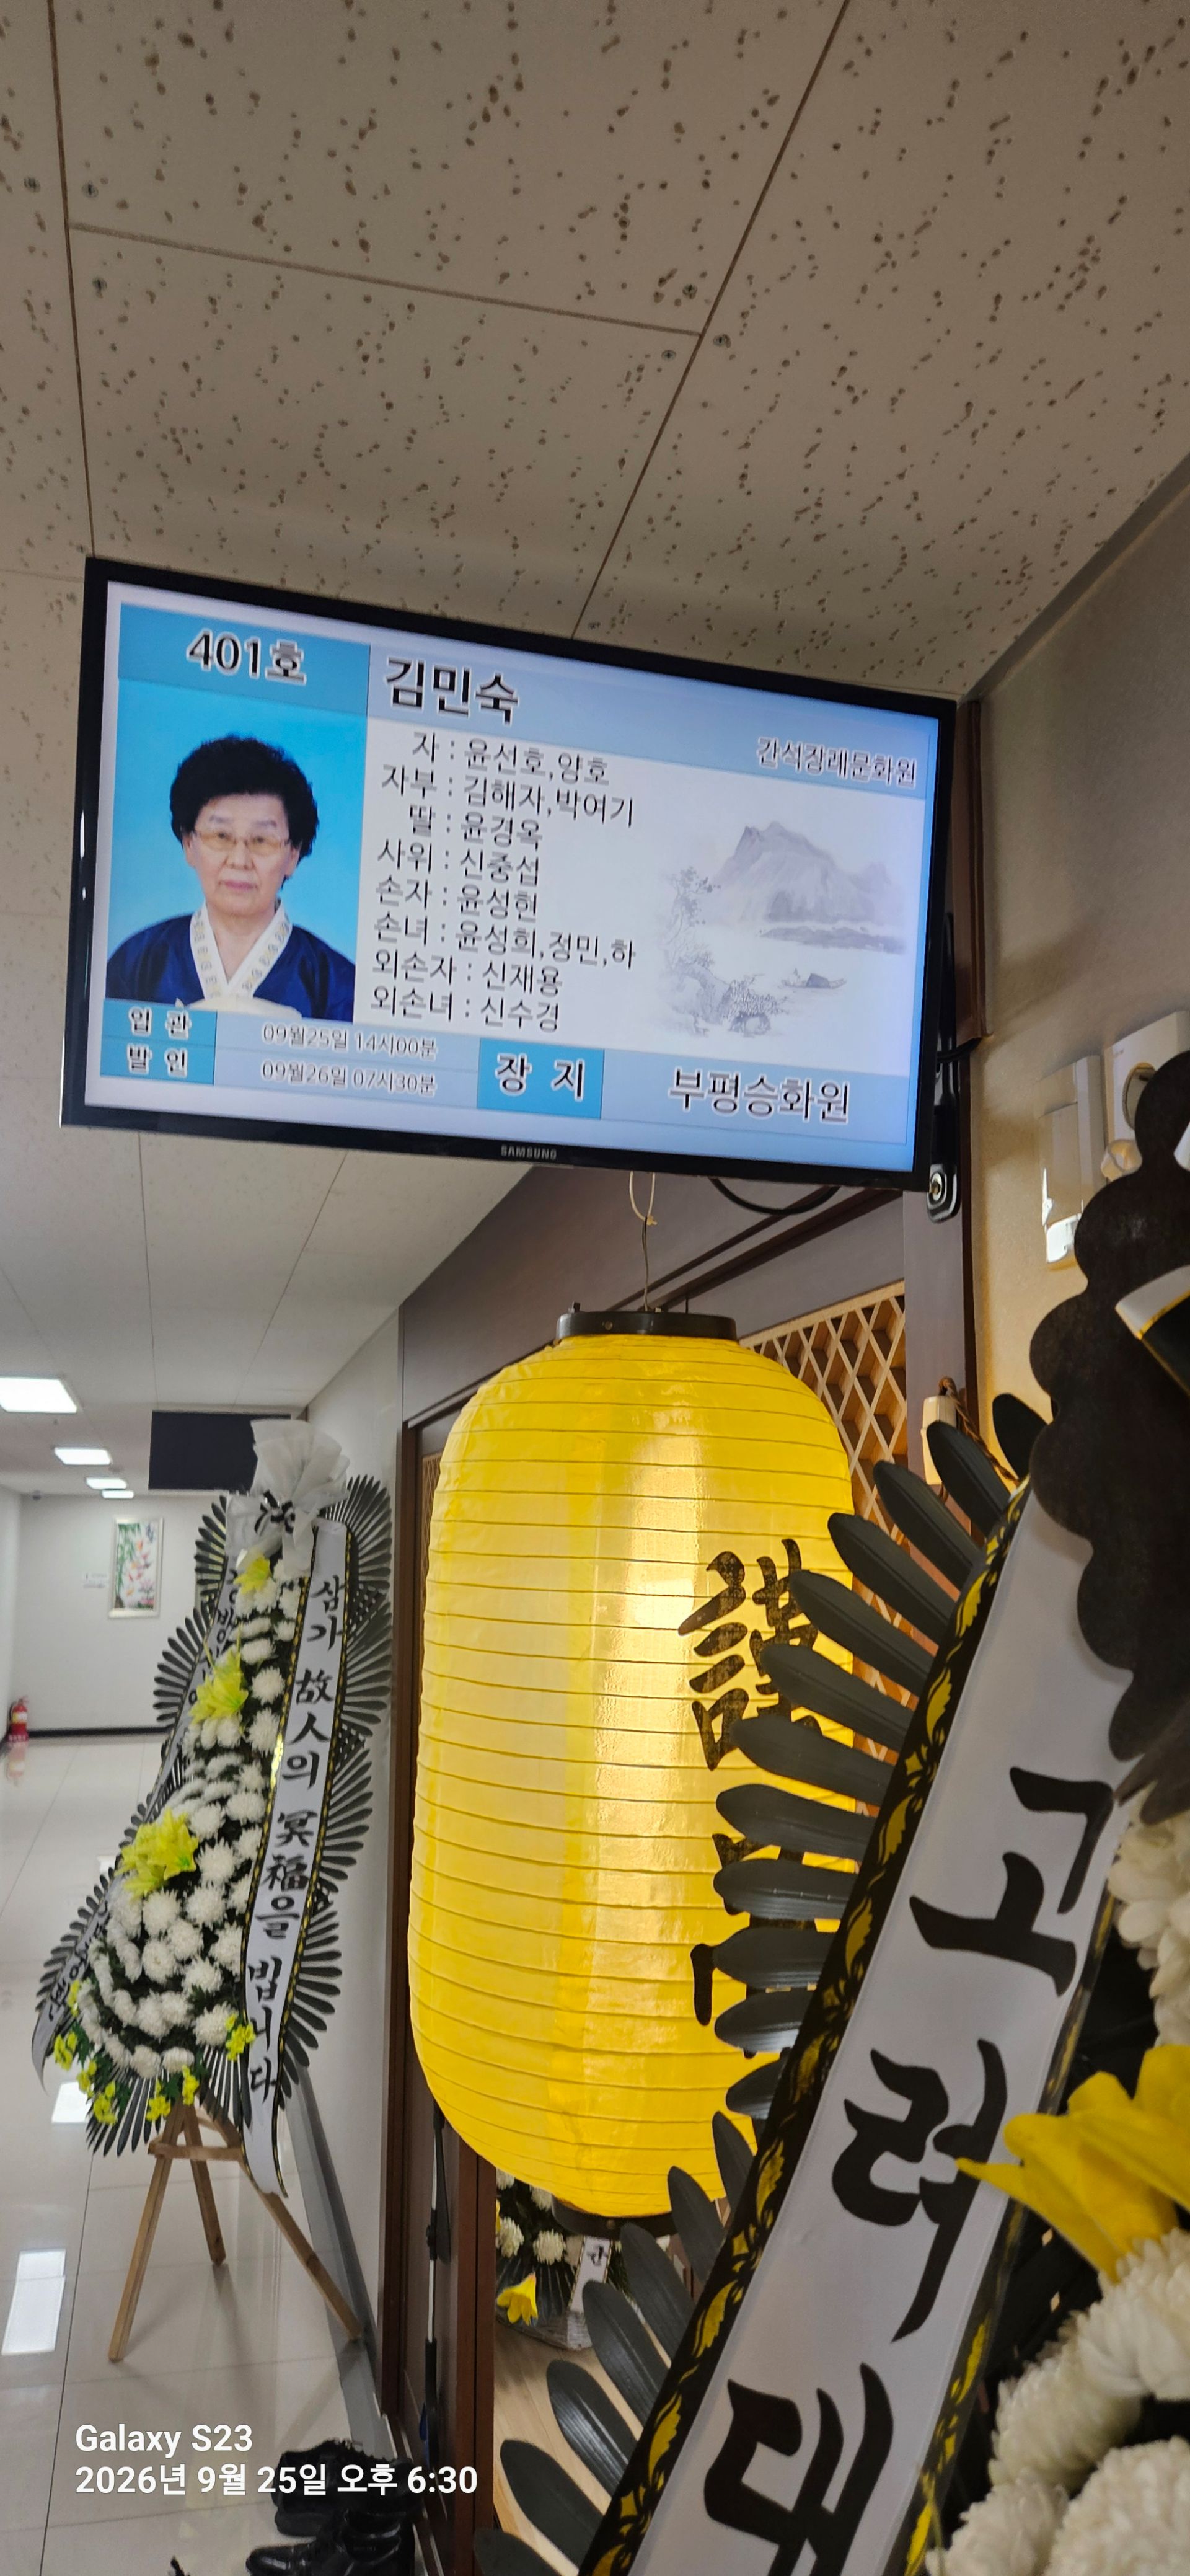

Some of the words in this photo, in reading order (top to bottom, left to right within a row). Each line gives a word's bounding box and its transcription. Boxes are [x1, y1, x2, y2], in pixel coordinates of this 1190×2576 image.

[187, 629, 306, 684] 401호
[385, 657, 519, 725] 김민숙
[412, 732, 439, 763] 자
[464, 738, 610, 786] 윤선호,양호
[757, 737, 915, 788] 간석장례문화원
[382, 764, 437, 799] 자부
[464, 775, 633, 828] 김해자,박여기
[410, 803, 436, 837] 딸
[461, 812, 543, 852] 윤경옥
[377, 839, 433, 874] 사위
[460, 849, 539, 887] 신중섭
[376, 875, 432, 909] 손자
[457, 883, 537, 923] 윤성현
[374, 911, 428, 947] 손녀
[456, 920, 636, 970] 윤성희,정민,하
[373, 949, 457, 985] 외손자
[482, 960, 563, 998] 신재용
[371, 985, 452, 1022] 외손녀
[481, 997, 559, 1033] 신수경
[263, 1024, 348, 1051] 09월25일
[356, 1032, 437, 1060] 14시00분
[262, 1060, 346, 1087] 09월26일
[353, 1068, 436, 1095] 07시30분
[669, 1068, 850, 1123] 부평승화원
[501, 1144, 557, 1161] SAMSUNG
[307, 1574, 345, 1651] 삼가
[283, 1669, 334, 1790] 故人의
[255, 1810, 318, 1939] 冥福을
[249, 1956, 283, 2101] 빕니다
